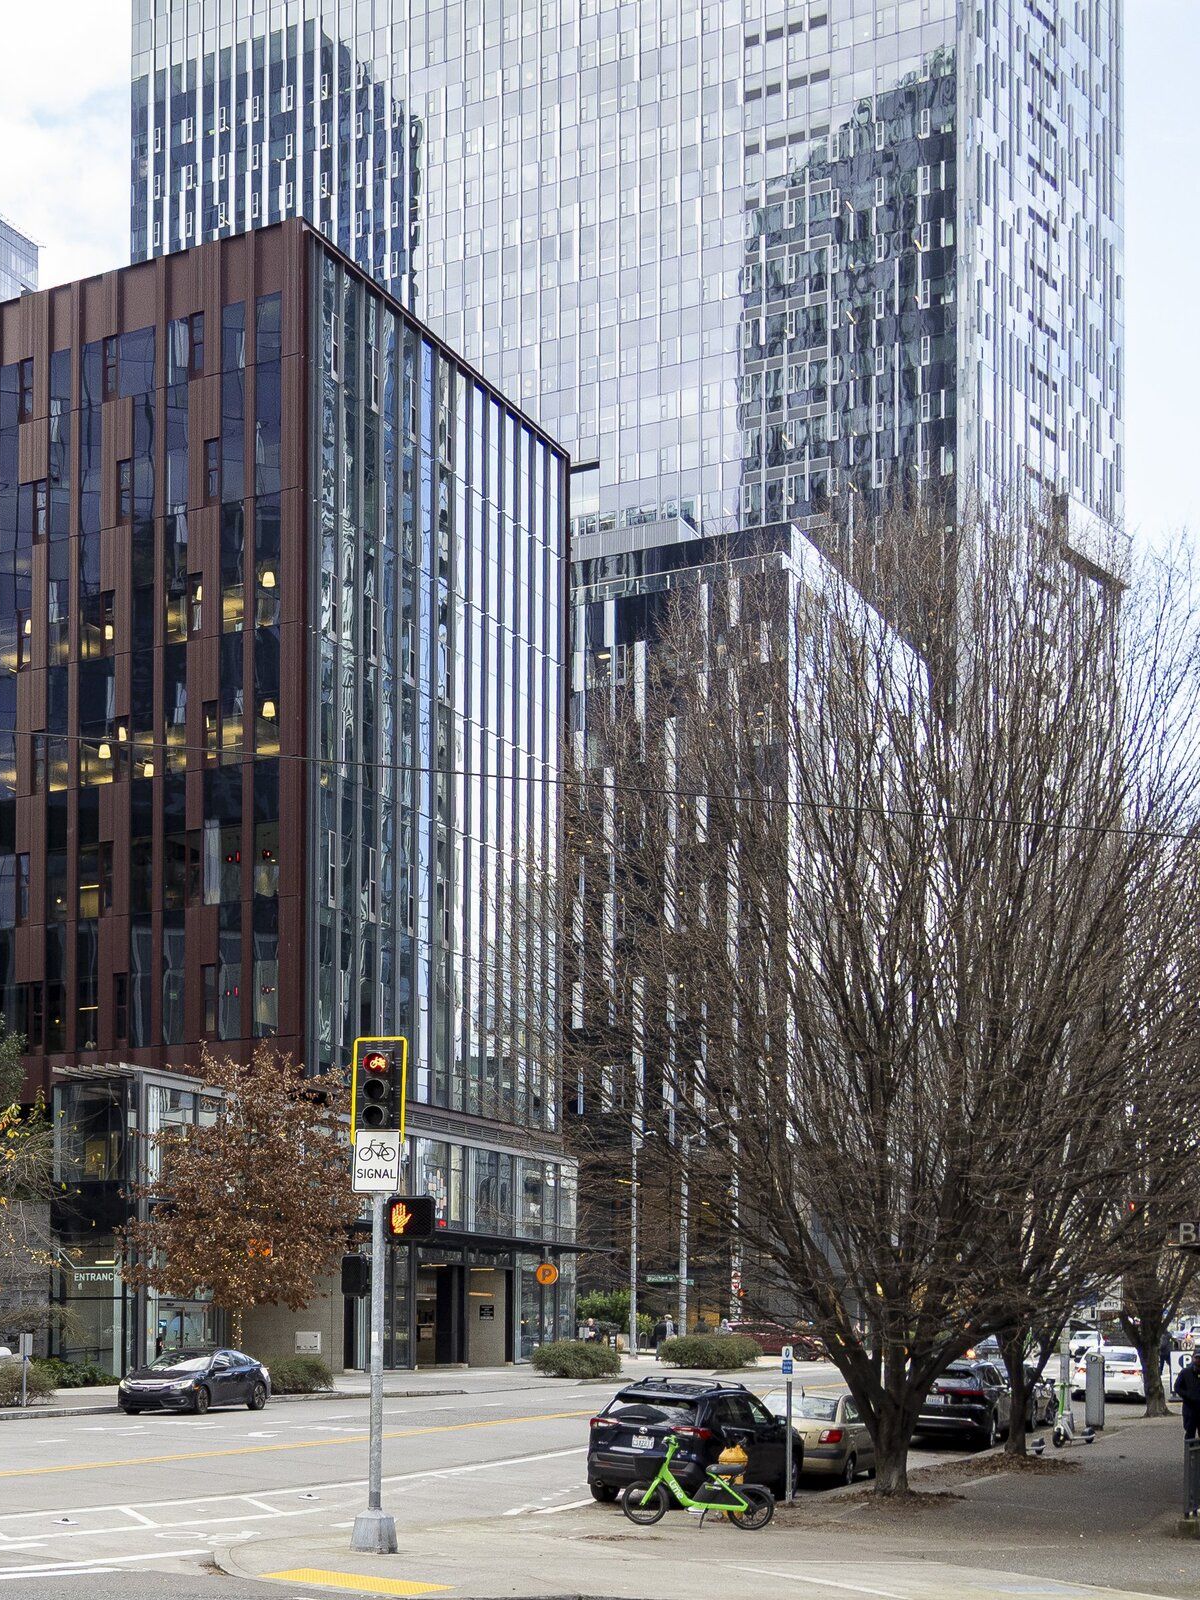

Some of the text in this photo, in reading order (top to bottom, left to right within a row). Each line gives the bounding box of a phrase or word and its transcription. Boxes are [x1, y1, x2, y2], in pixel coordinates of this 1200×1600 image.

[356, 1168, 397, 1179] SIGNAL
[1179, 1222, 1200, 1244] B
[74, 1272, 119, 1282] ENTRANC
[1183, 1355, 1192, 1368] P
